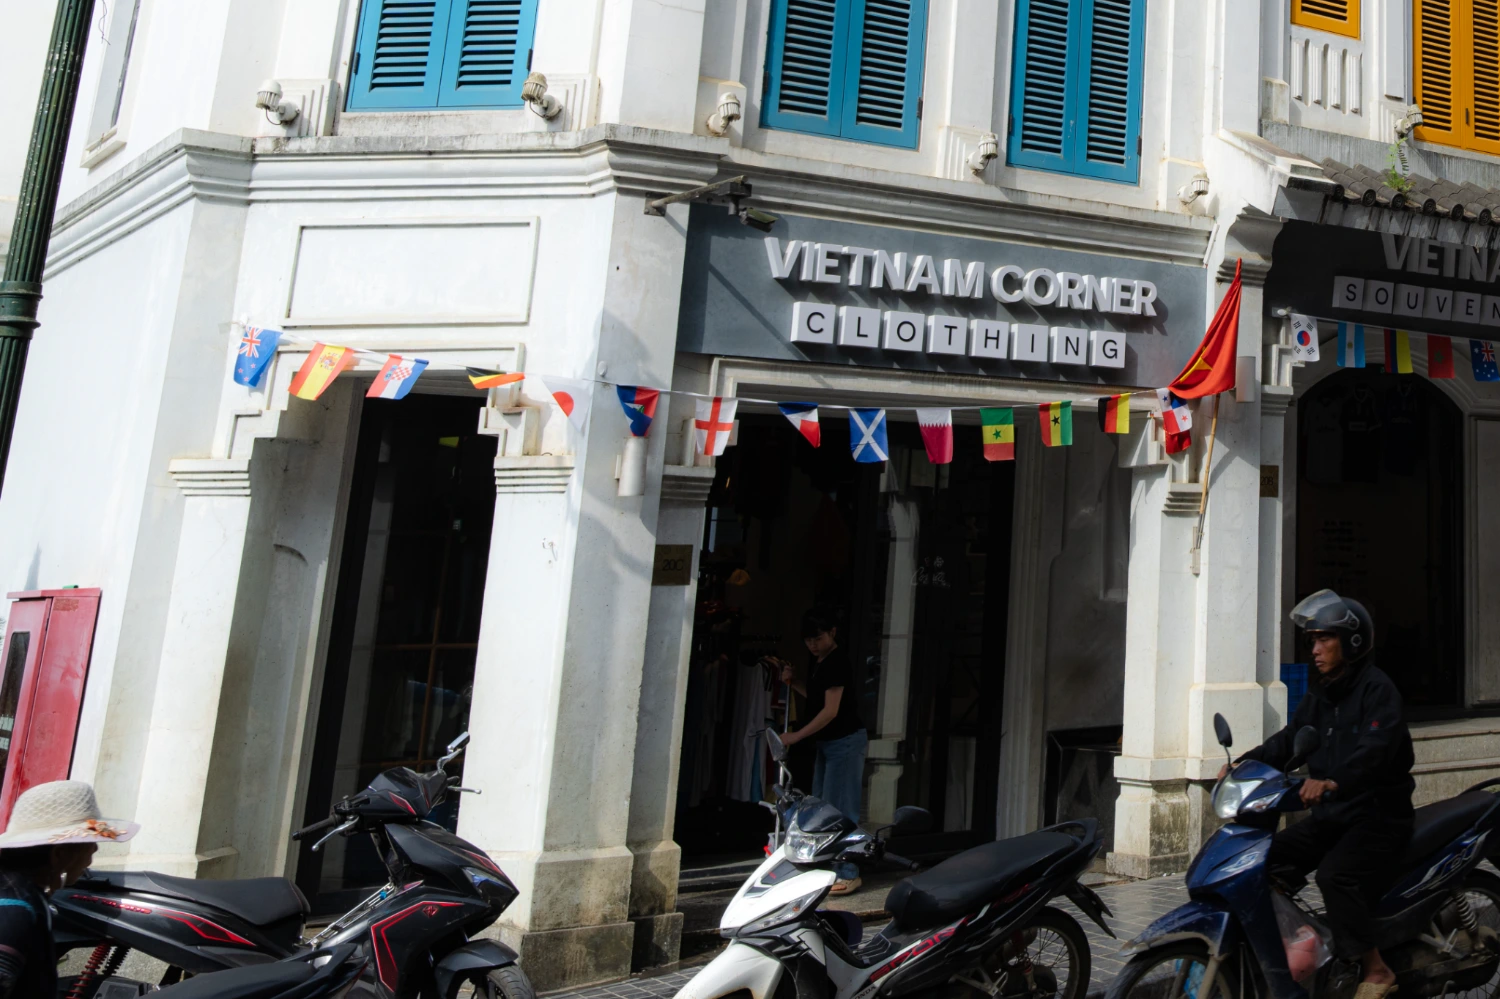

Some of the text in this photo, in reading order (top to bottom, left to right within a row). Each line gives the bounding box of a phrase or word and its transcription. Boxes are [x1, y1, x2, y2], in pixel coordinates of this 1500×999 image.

[764, 236, 1157, 317] VIETNAM CORNER
[805, 310, 1119, 361] CLOTHING
[662, 559, 685, 571] 20C
